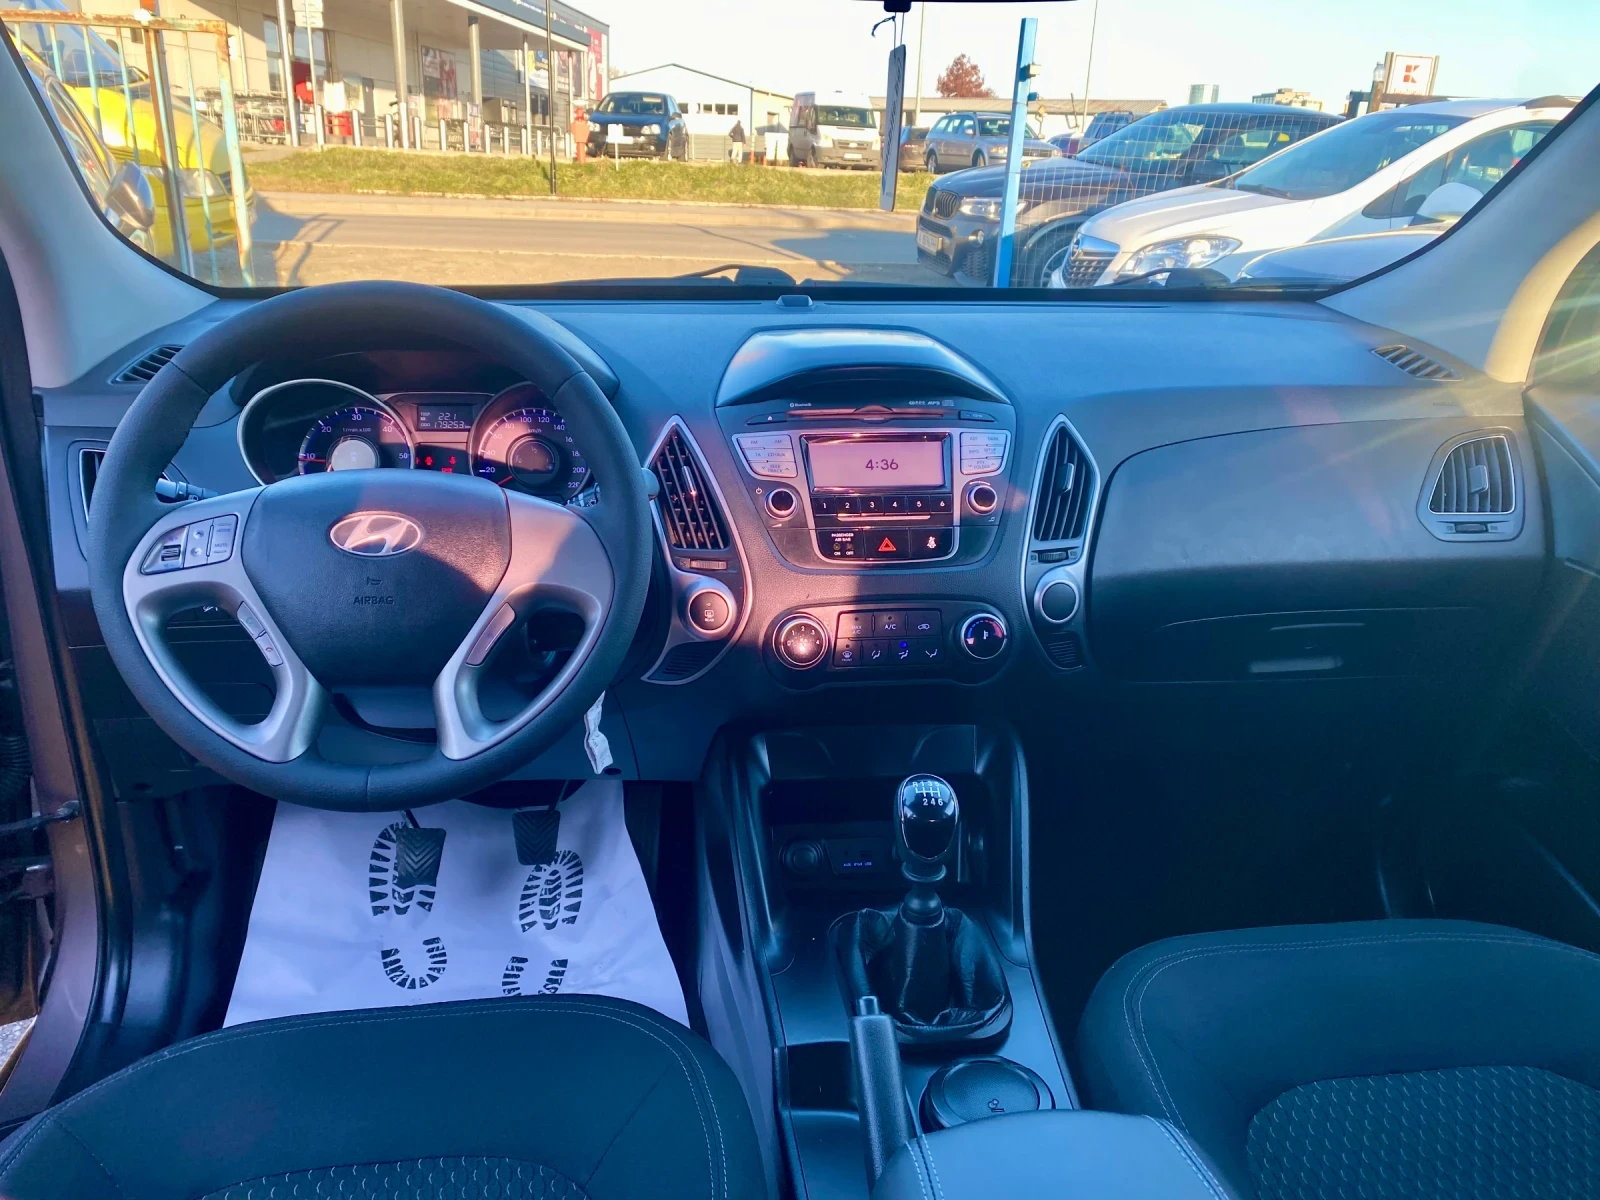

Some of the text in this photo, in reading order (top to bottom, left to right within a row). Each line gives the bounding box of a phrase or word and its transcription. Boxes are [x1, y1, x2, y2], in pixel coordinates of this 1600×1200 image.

[351, 413, 362, 421] 30
[519, 416, 532, 424] 100
[538, 416, 550, 424] 120
[321, 425, 332, 433] 20
[382, 425, 393, 433] 40
[505, 422, 515, 430] 80
[398, 452, 408, 460] 50
[865, 458, 899, 471] 4:36
[572, 466, 585, 474] 200
[353, 595, 395, 605] AIRBAG
[922, 798, 929, 806] 2
[930, 798, 936, 806] 4
[937, 798, 944, 806] 6
